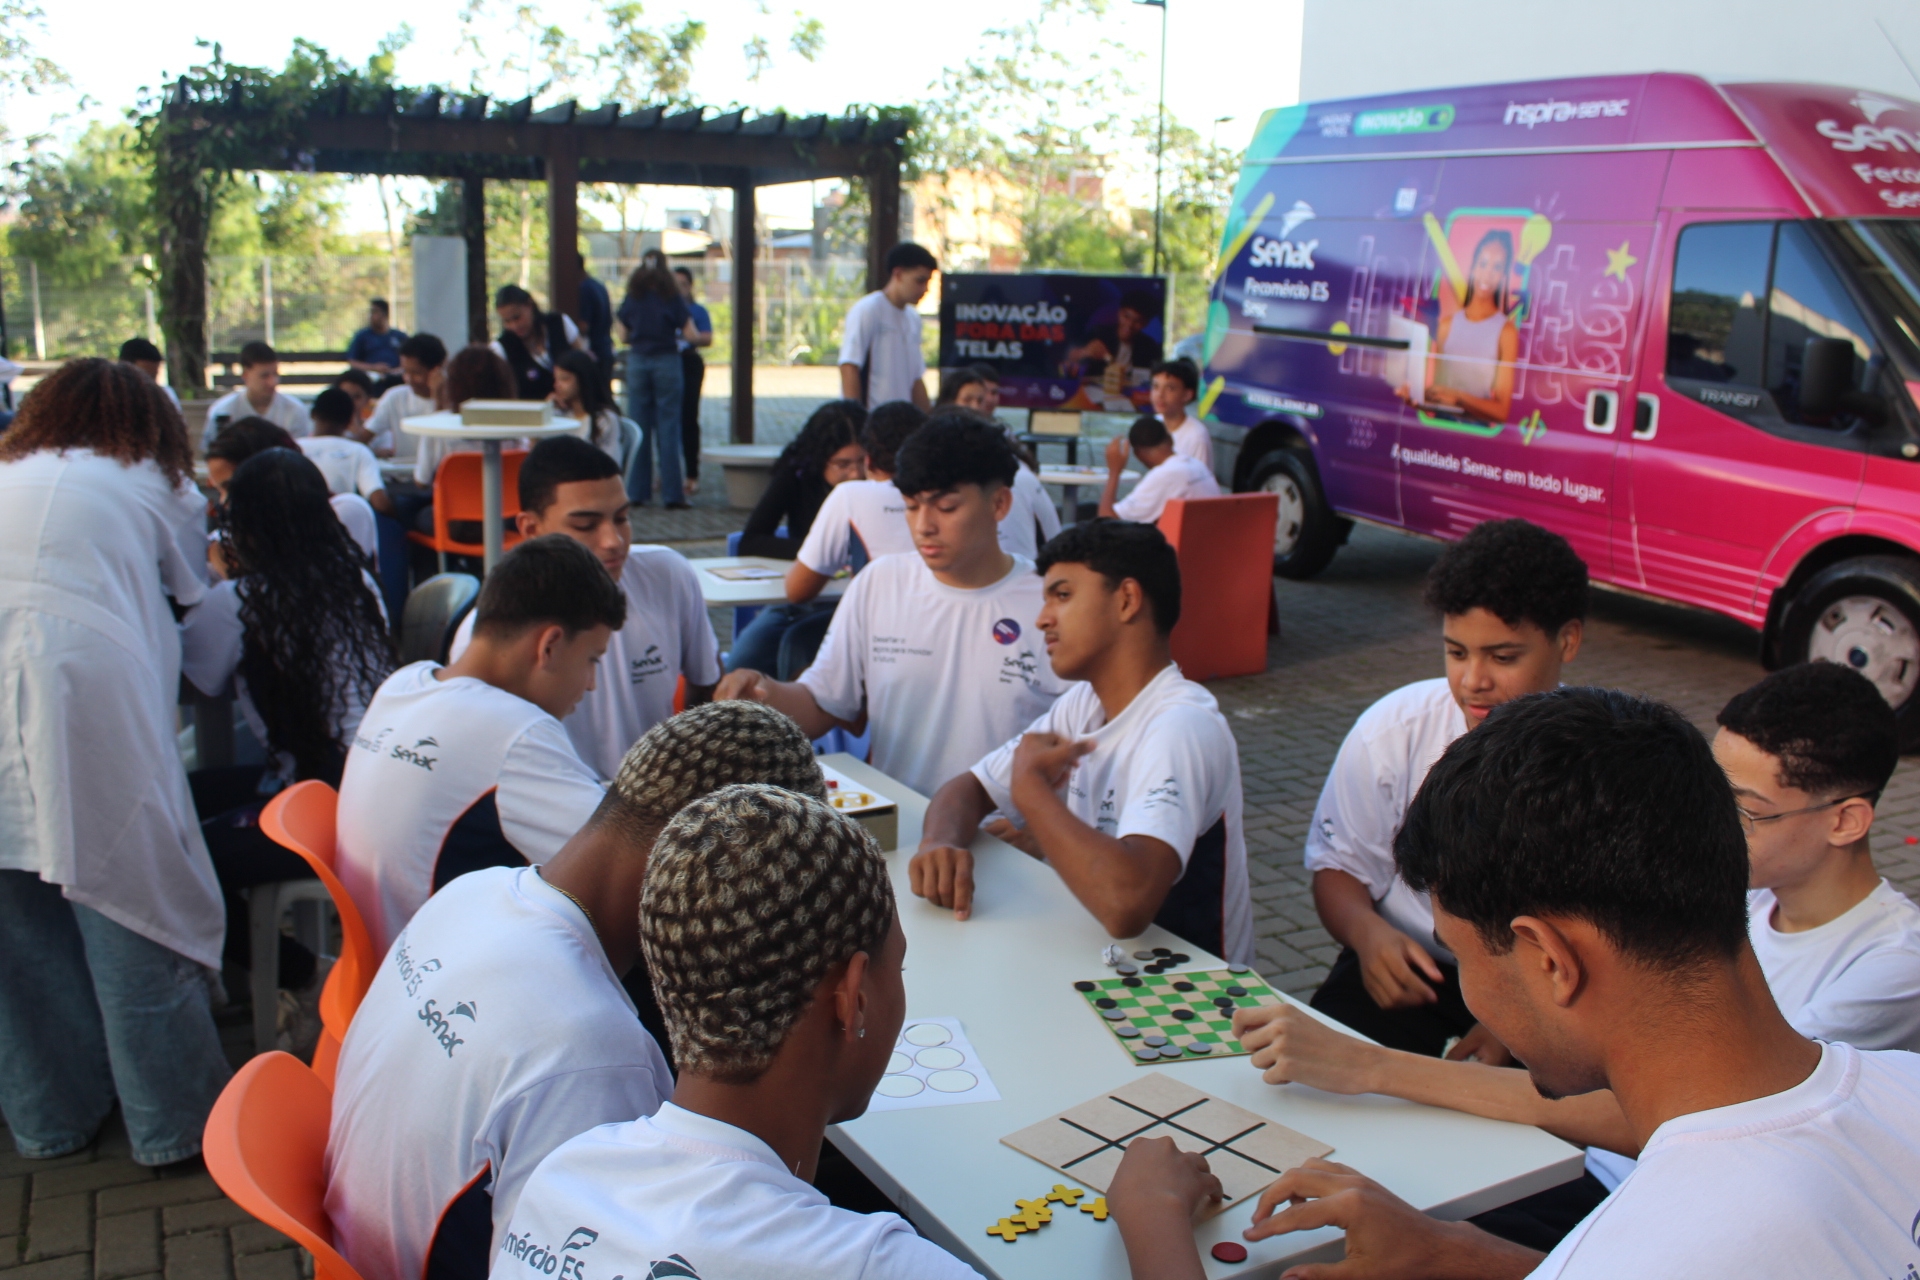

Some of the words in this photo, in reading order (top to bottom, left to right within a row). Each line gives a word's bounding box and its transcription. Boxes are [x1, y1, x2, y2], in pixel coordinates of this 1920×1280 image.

[1243, 276, 1310, 300] Fecomércio
[1310, 281, 1330, 302] ES
[955, 302, 1067, 326] INOVAÇÃO
[955, 322, 1016, 340] FORA
[1020, 324, 1066, 341] DAS
[955, 341, 1024, 359] TELAS
[1701, 387, 1760, 408] TRANSIT
[1391, 442, 1401, 459] A
[1401, 448, 1460, 472] qualidade
[1461, 457, 1502, 481] Senac
[1502, 469, 1526, 487] em
[1527, 470, 1562, 493] todo
[1562, 478, 1606, 503] lugar.
[390, 744, 439, 772] Senac
[418, 998, 465, 1059] Senac
